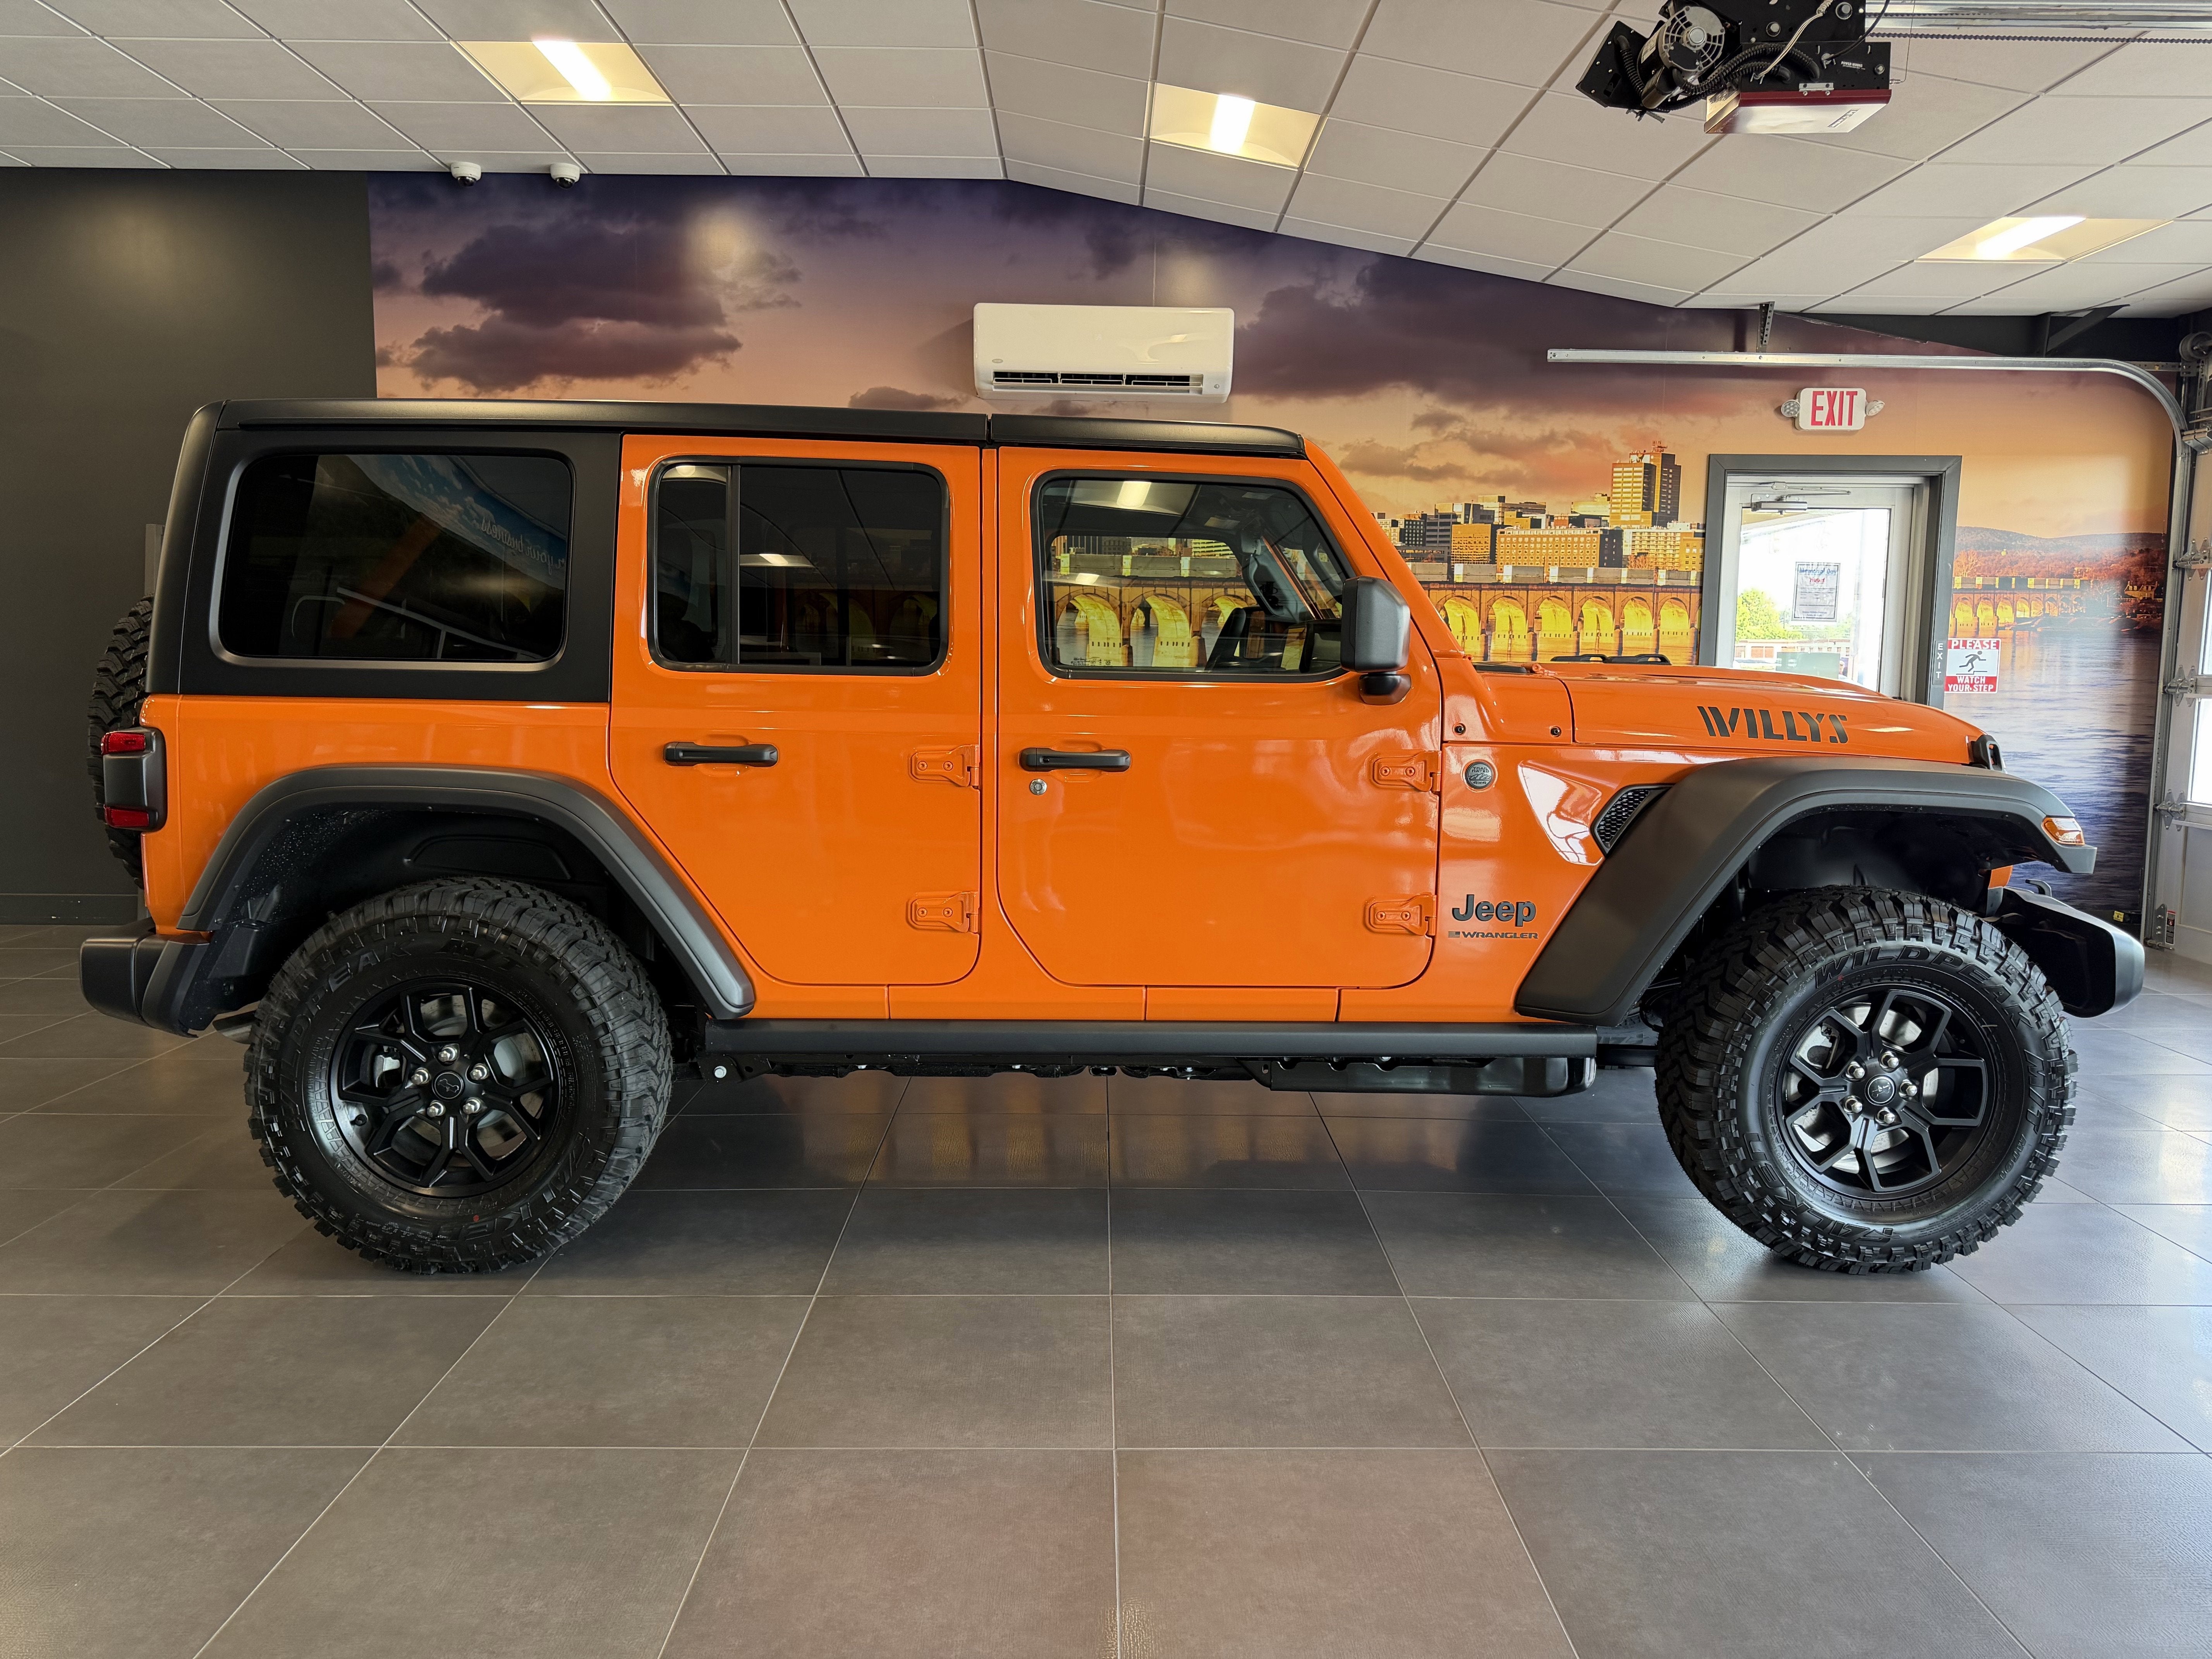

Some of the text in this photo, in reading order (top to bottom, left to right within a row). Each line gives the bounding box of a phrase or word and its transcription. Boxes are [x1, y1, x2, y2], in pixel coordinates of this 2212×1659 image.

[1811, 391, 1858, 426] EXIT
[1936, 643, 1944, 679] EXIT
[1951, 640, 1997, 649] PLEASE
[1697, 706, 1848, 744] WILLYS
[1452, 894, 1536, 927] Jeep
[1462, 931, 1538, 939] WRANGLER
[1815, 945, 2033, 1029] WILDPEAK
[2023, 1049, 2045, 1134] M/T
[1743, 1132, 1901, 1242] FALKEN
